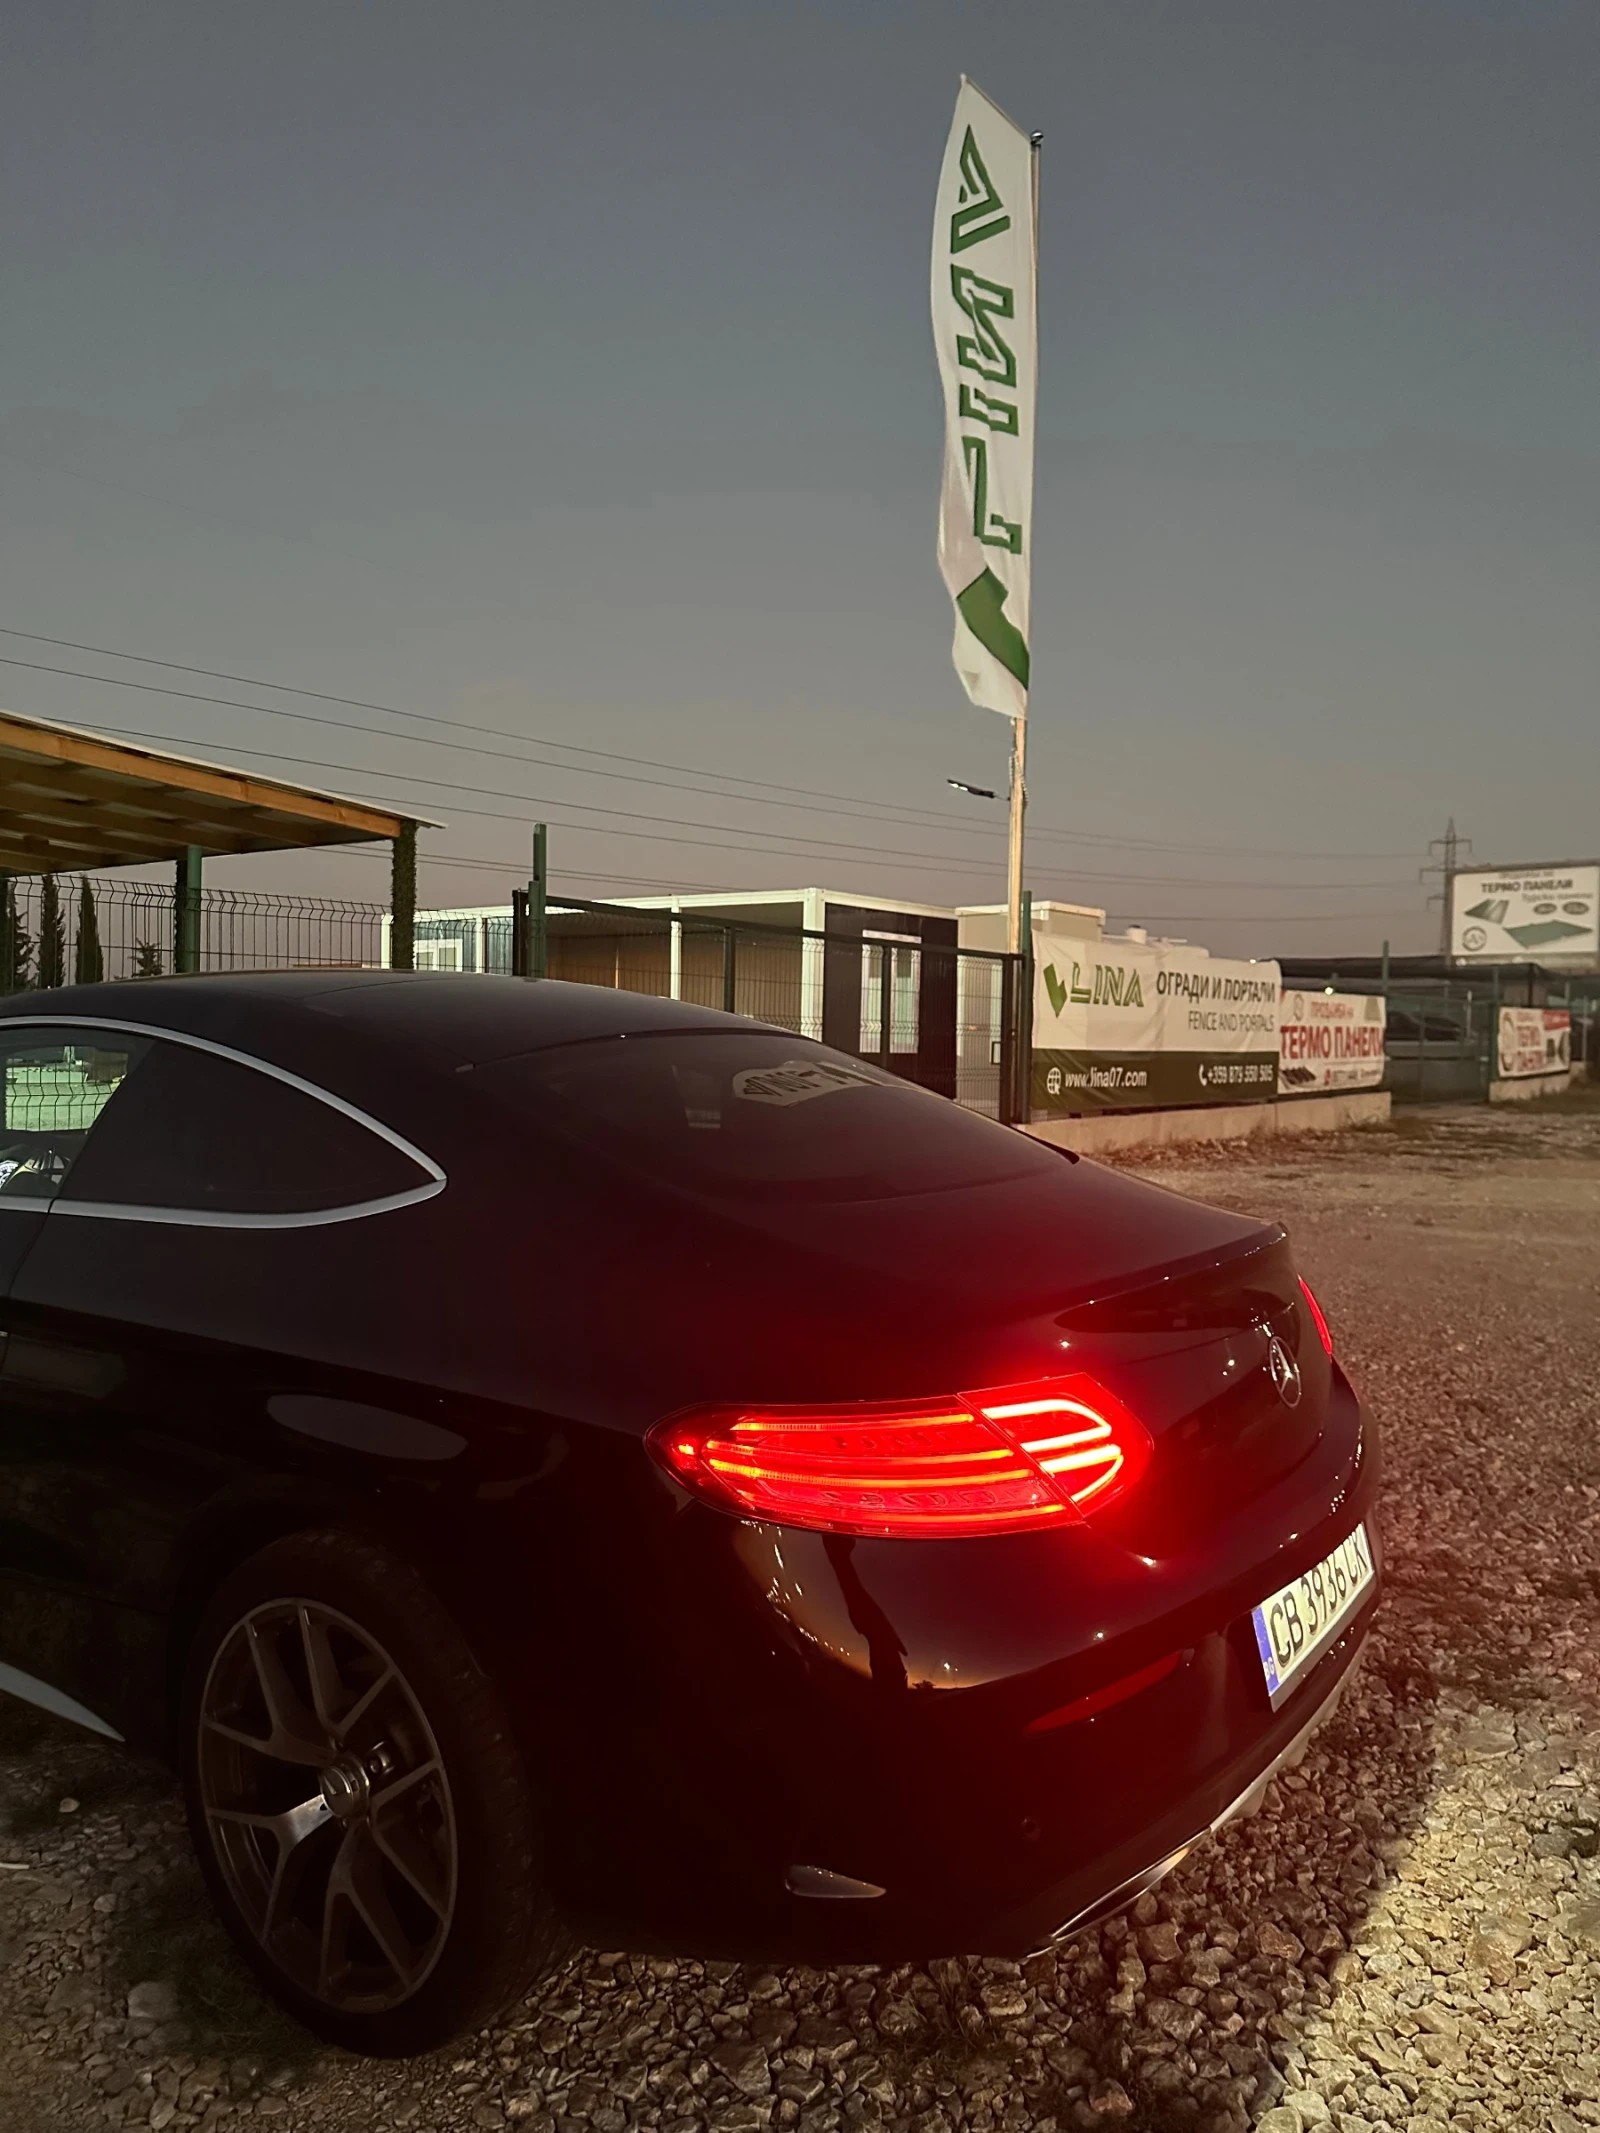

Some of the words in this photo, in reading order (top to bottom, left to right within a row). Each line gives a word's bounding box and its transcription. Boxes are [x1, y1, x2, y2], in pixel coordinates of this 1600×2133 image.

[1070, 961, 1144, 1007] LINA
[1156, 971, 1209, 1003] ОГРАДИ
[1212, 978, 1221, 999] И
[1224, 977, 1276, 1003] ПОРТАЛИ
[1188, 1011, 1217, 1031] FENCE
[1218, 1012, 1238, 1032] AND
[1239, 1013, 1274, 1032] PORTALS
[1280, 1025, 1332, 1059] ТЕРМО
[1334, 1025, 1383, 1058] ПАНЕЛИ
[1065, 1066, 1147, 1088] www.lina07.com
[1270, 1591, 1304, 1668] CB
[1301, 1553, 1347, 1635] 3936
[1263, 1657, 1275, 1681] BG
